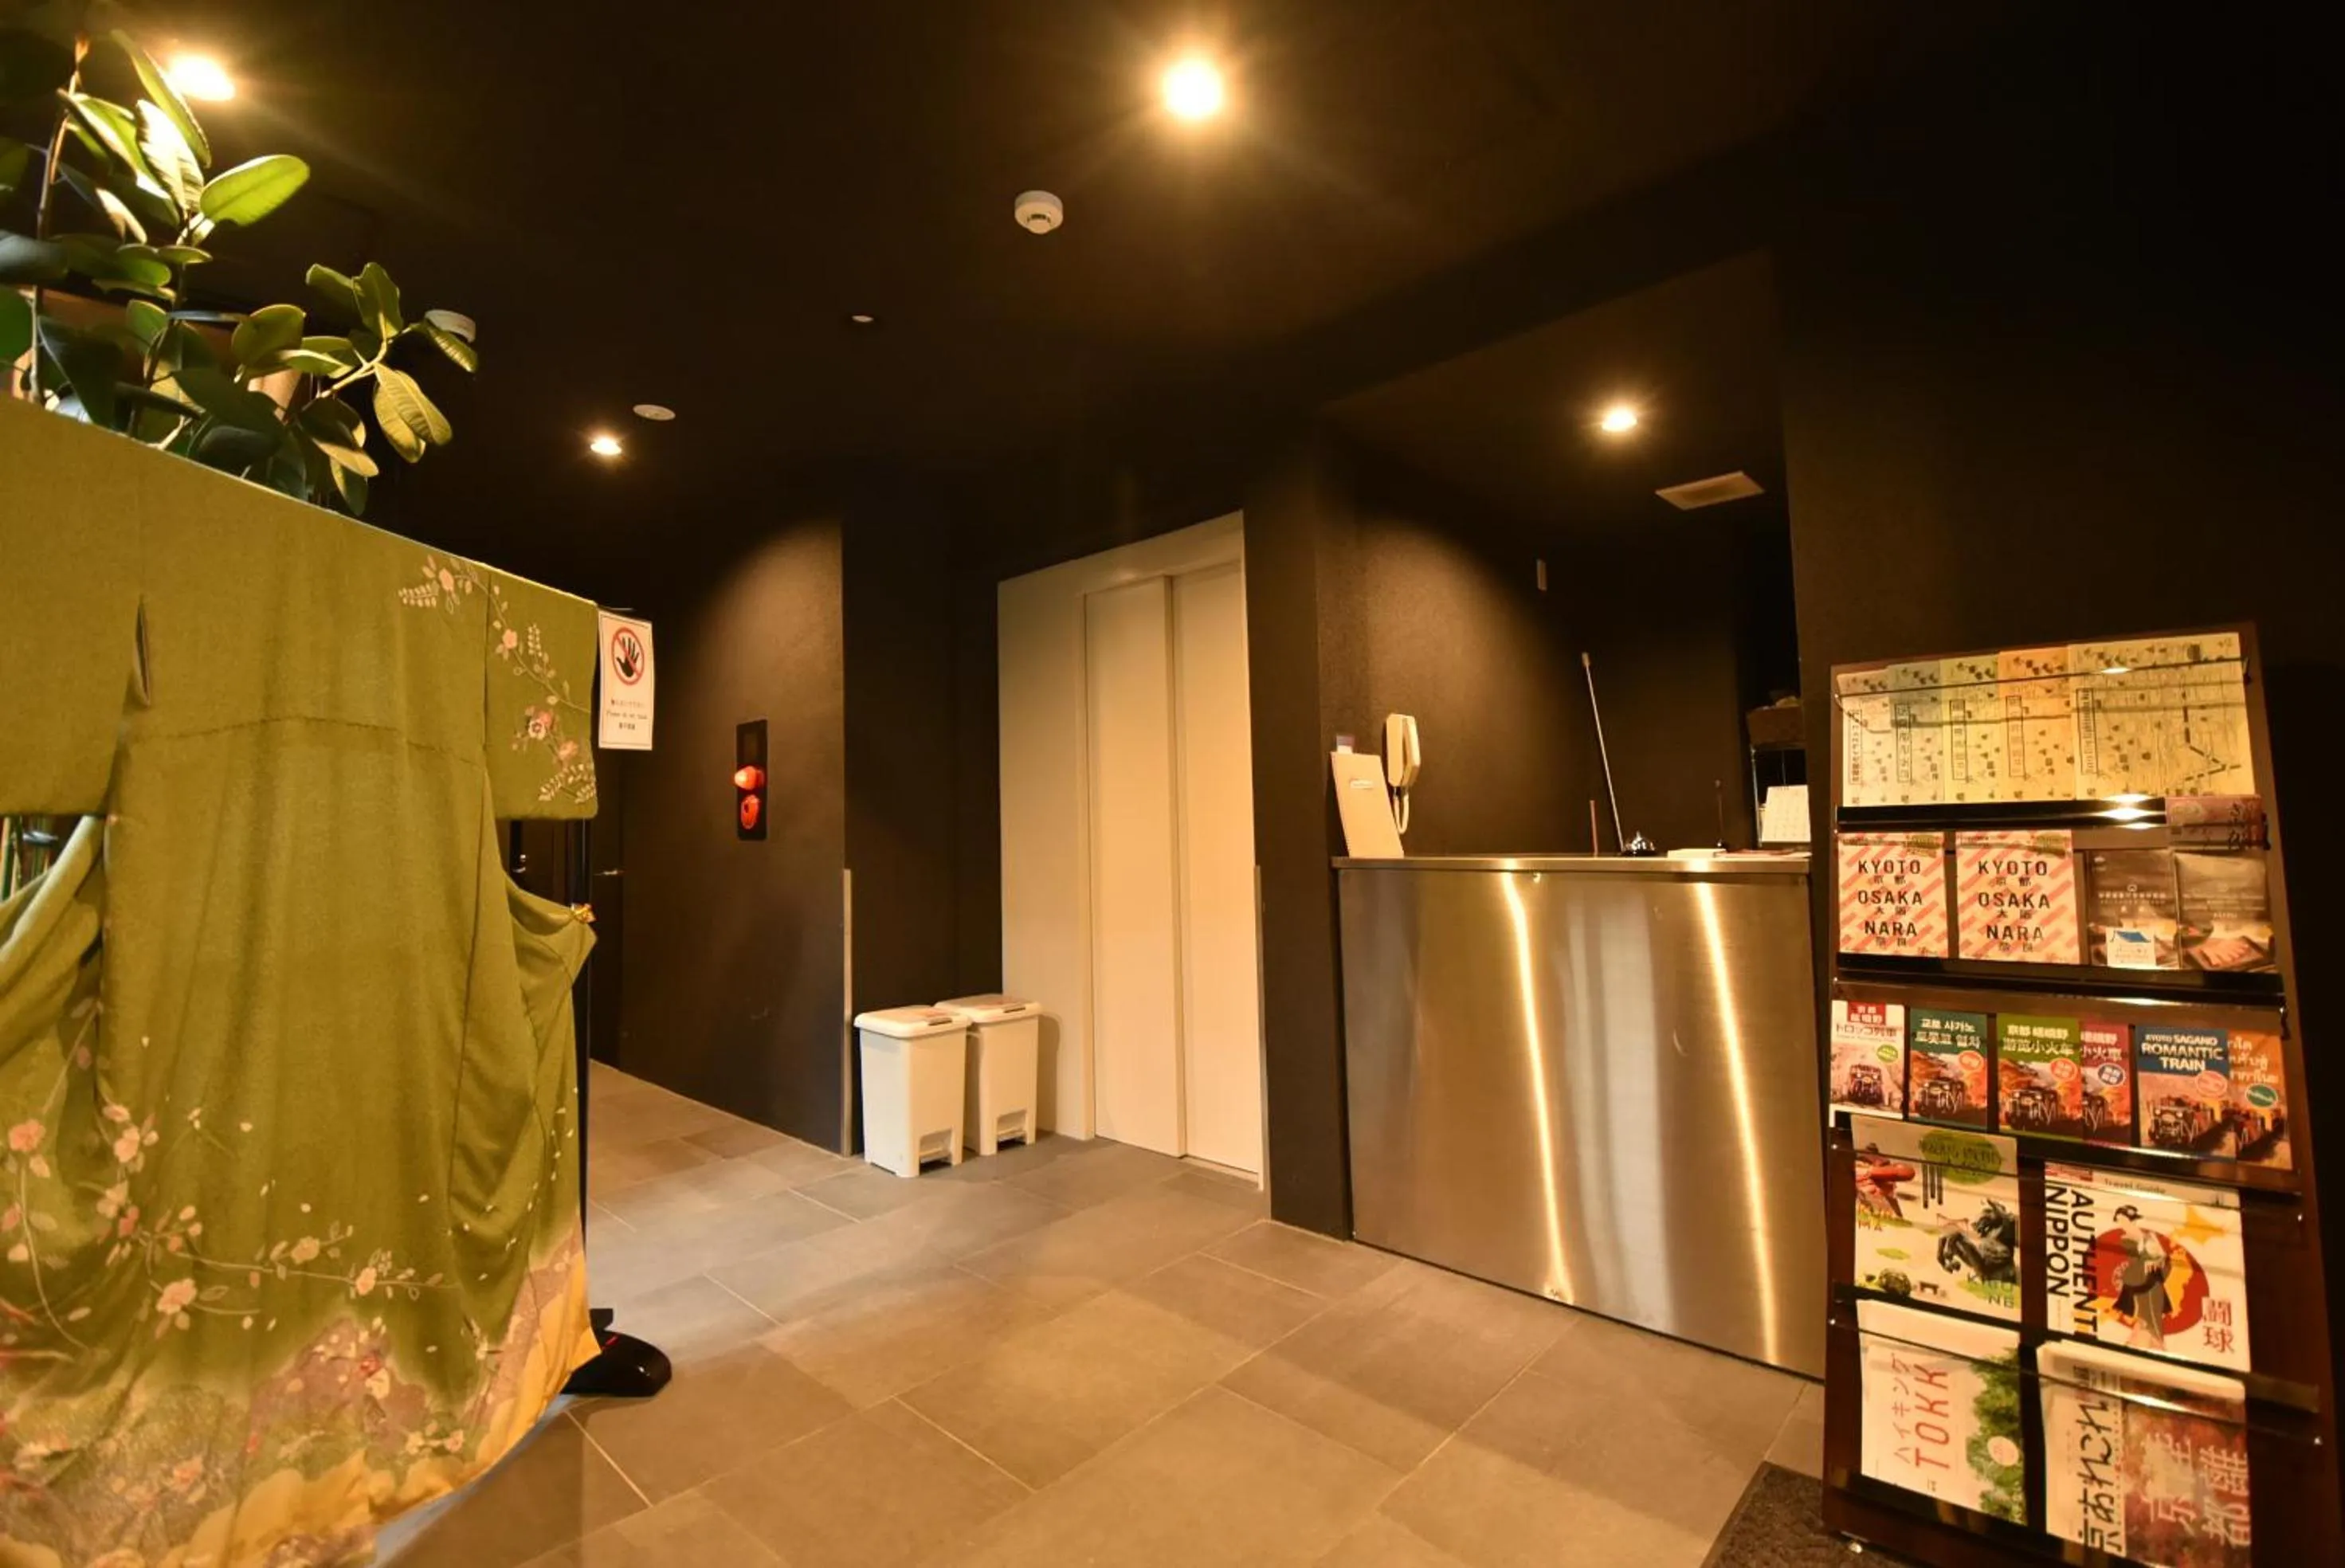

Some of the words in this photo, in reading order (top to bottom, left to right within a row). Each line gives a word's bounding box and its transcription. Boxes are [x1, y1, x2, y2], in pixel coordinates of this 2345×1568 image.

[1858, 860, 1921, 875] KYOTO
[1978, 860, 2047, 876] KYOTO
[1857, 890, 1922, 905] OSAKA
[1978, 892, 2050, 908] OSAKA
[1865, 921, 1917, 936] NARA
[1986, 925, 2044, 941] NARA
[2173, 1034, 2218, 1046] SAGANO
[2141, 1042, 2225, 1060] ROMANTIC
[2159, 1056, 2206, 1072] TRAIN
[2045, 1186, 2070, 1298] NIPPON
[1892, 1352, 1911, 1464] ハイキング
[1913, 1363, 1951, 1469] TOKK
[2076, 1400, 2122, 1553] 京あれこれ
